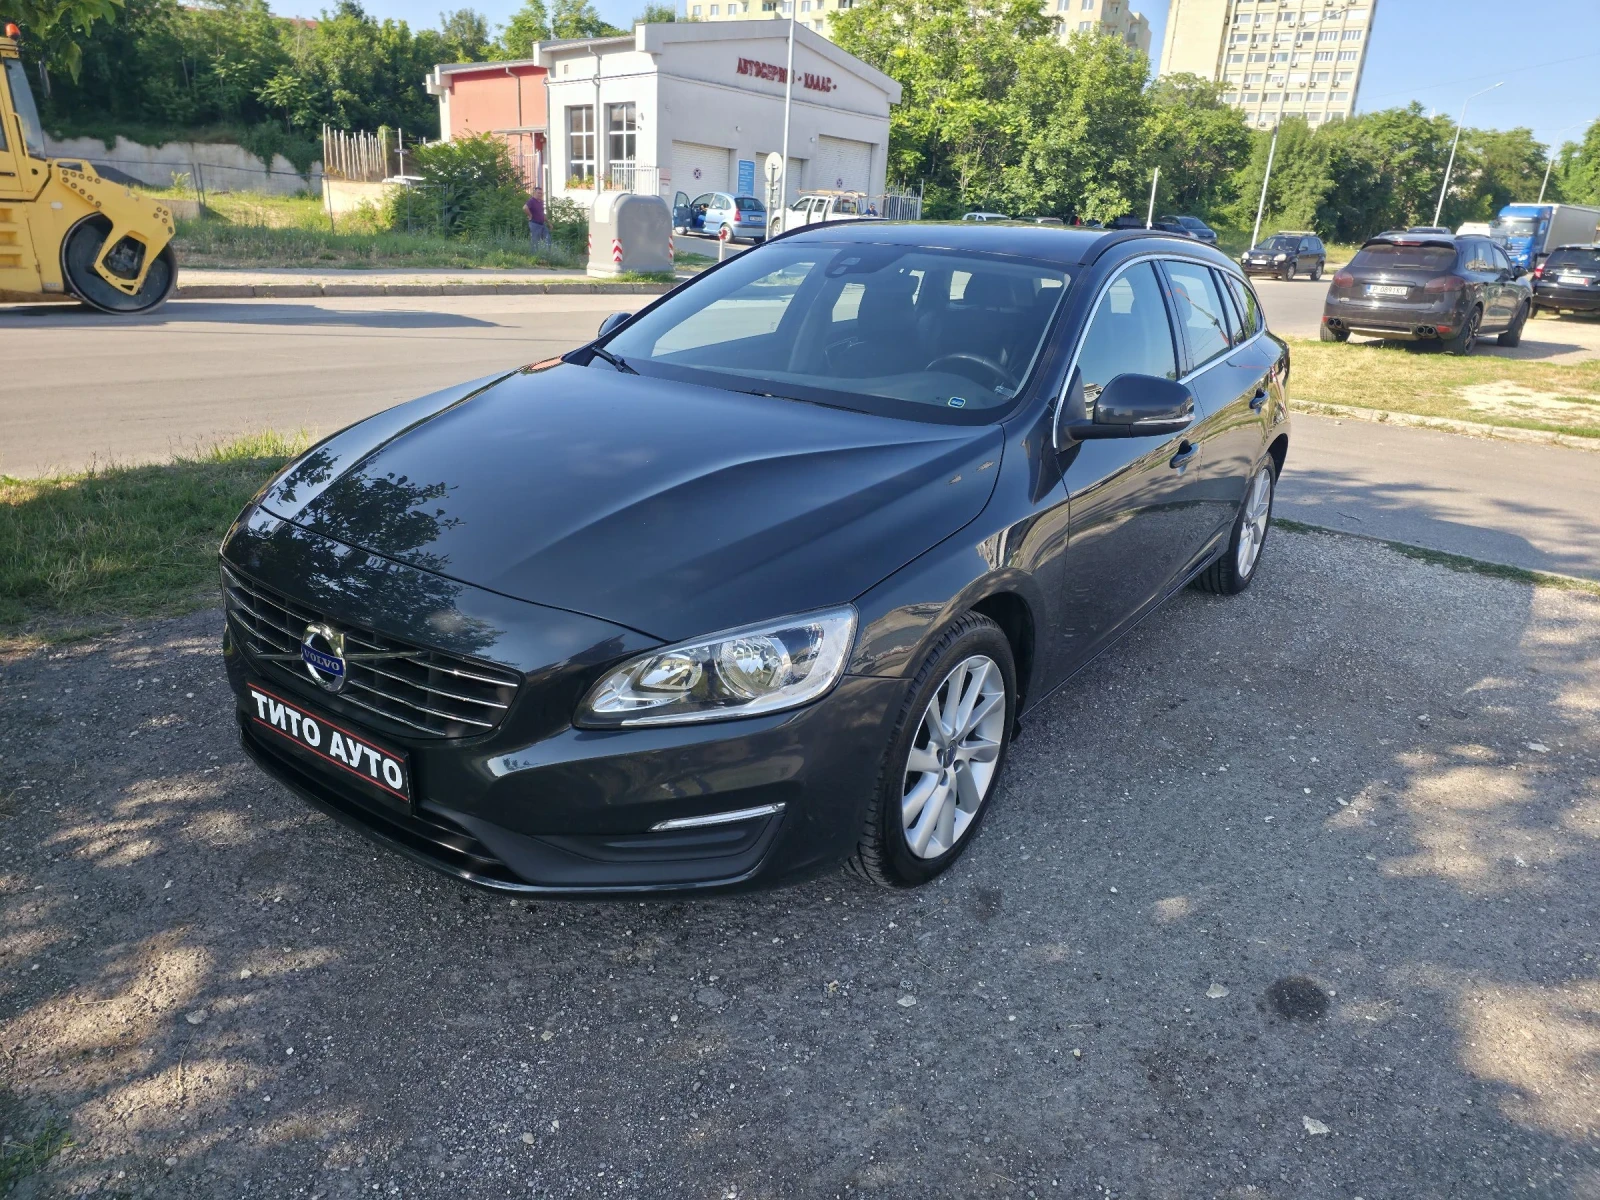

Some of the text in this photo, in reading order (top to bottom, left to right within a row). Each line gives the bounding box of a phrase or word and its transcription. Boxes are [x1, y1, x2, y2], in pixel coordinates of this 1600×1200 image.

[303, 648, 340, 671] VOLVO
[251, 690, 403, 790] ТИТО АУТО
